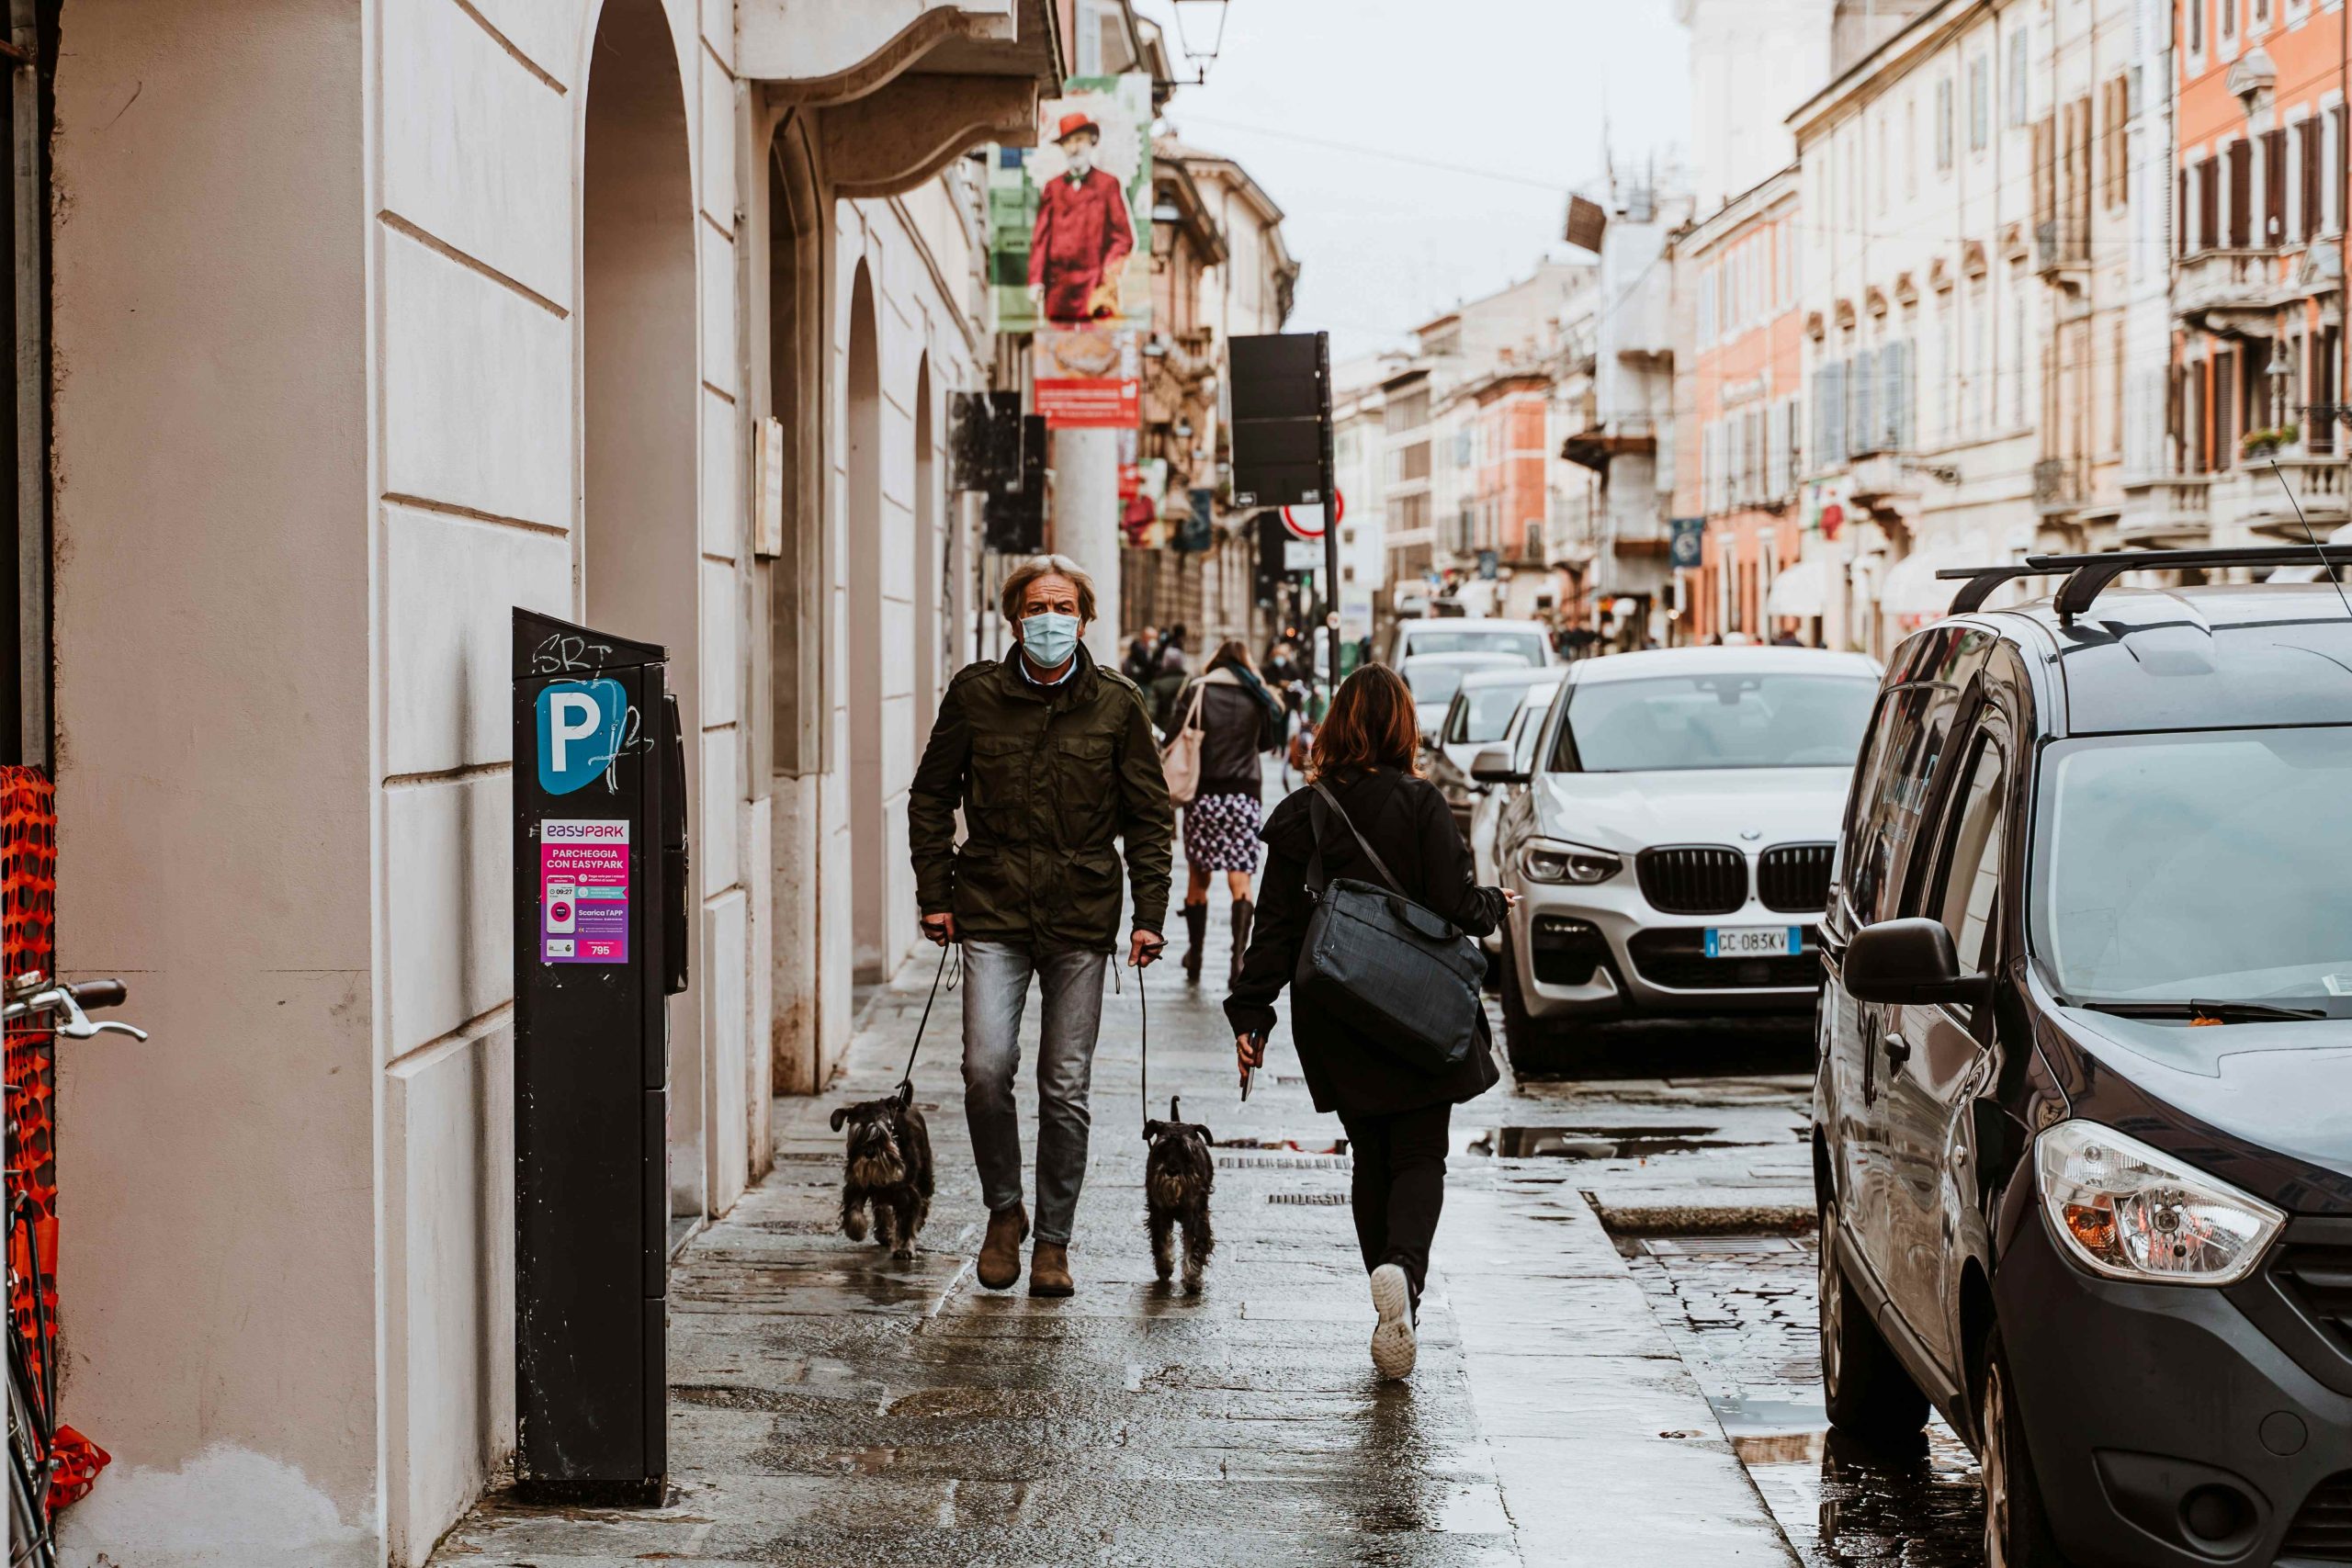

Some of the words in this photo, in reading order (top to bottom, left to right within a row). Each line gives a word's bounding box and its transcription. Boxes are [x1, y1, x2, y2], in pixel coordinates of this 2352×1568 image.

[550, 692, 601, 773] P
[552, 849, 618, 858] PARCHEGGIA
[547, 860, 570, 868] CON
[571, 860, 624, 869] EASYPARK
[591, 946, 610, 955] 795
